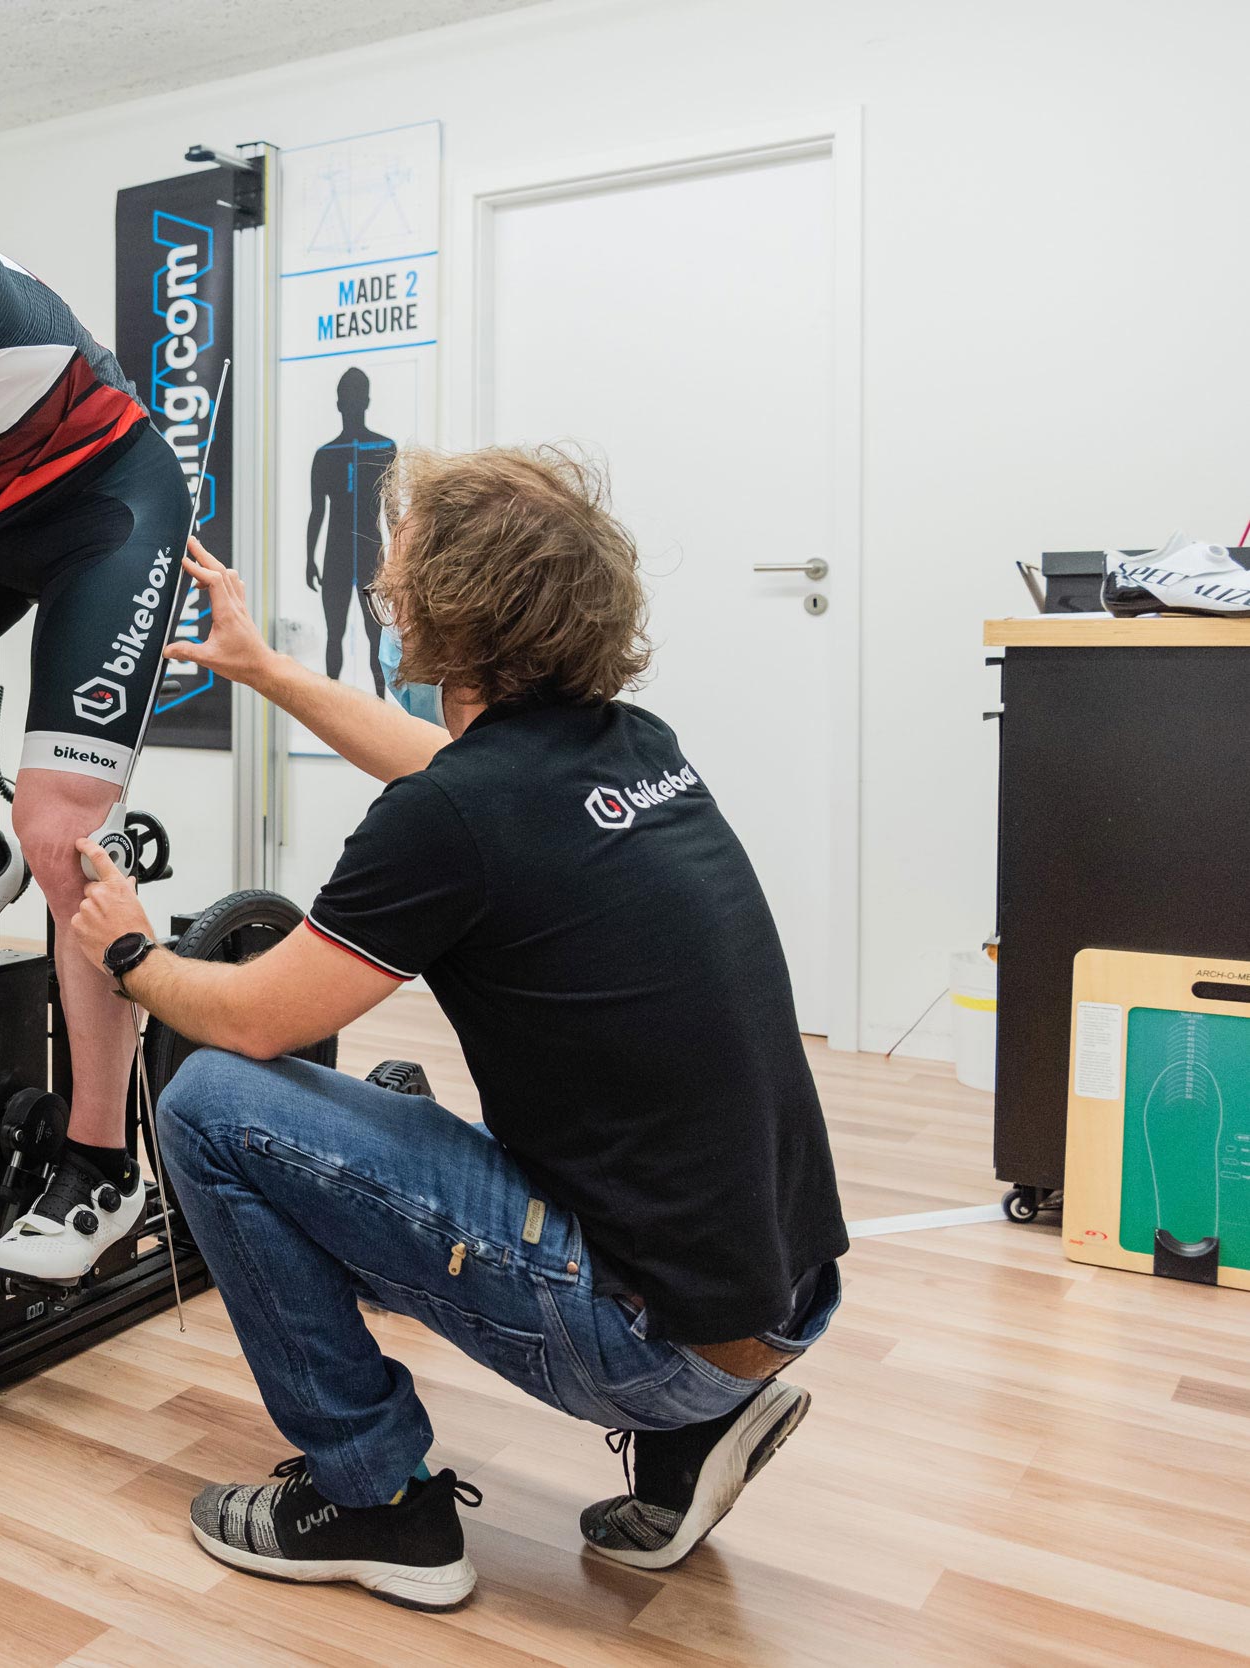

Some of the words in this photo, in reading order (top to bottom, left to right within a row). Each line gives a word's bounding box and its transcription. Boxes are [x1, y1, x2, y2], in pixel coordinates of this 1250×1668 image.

[339, 274, 397, 307] MADE
[405, 270, 418, 298] 2
[318, 303, 418, 341] MEASURE
[1118, 562, 1250, 607] SPECALIZ
[53, 745, 118, 770] bikebox
[101, 834, 130, 850] fitting.com
